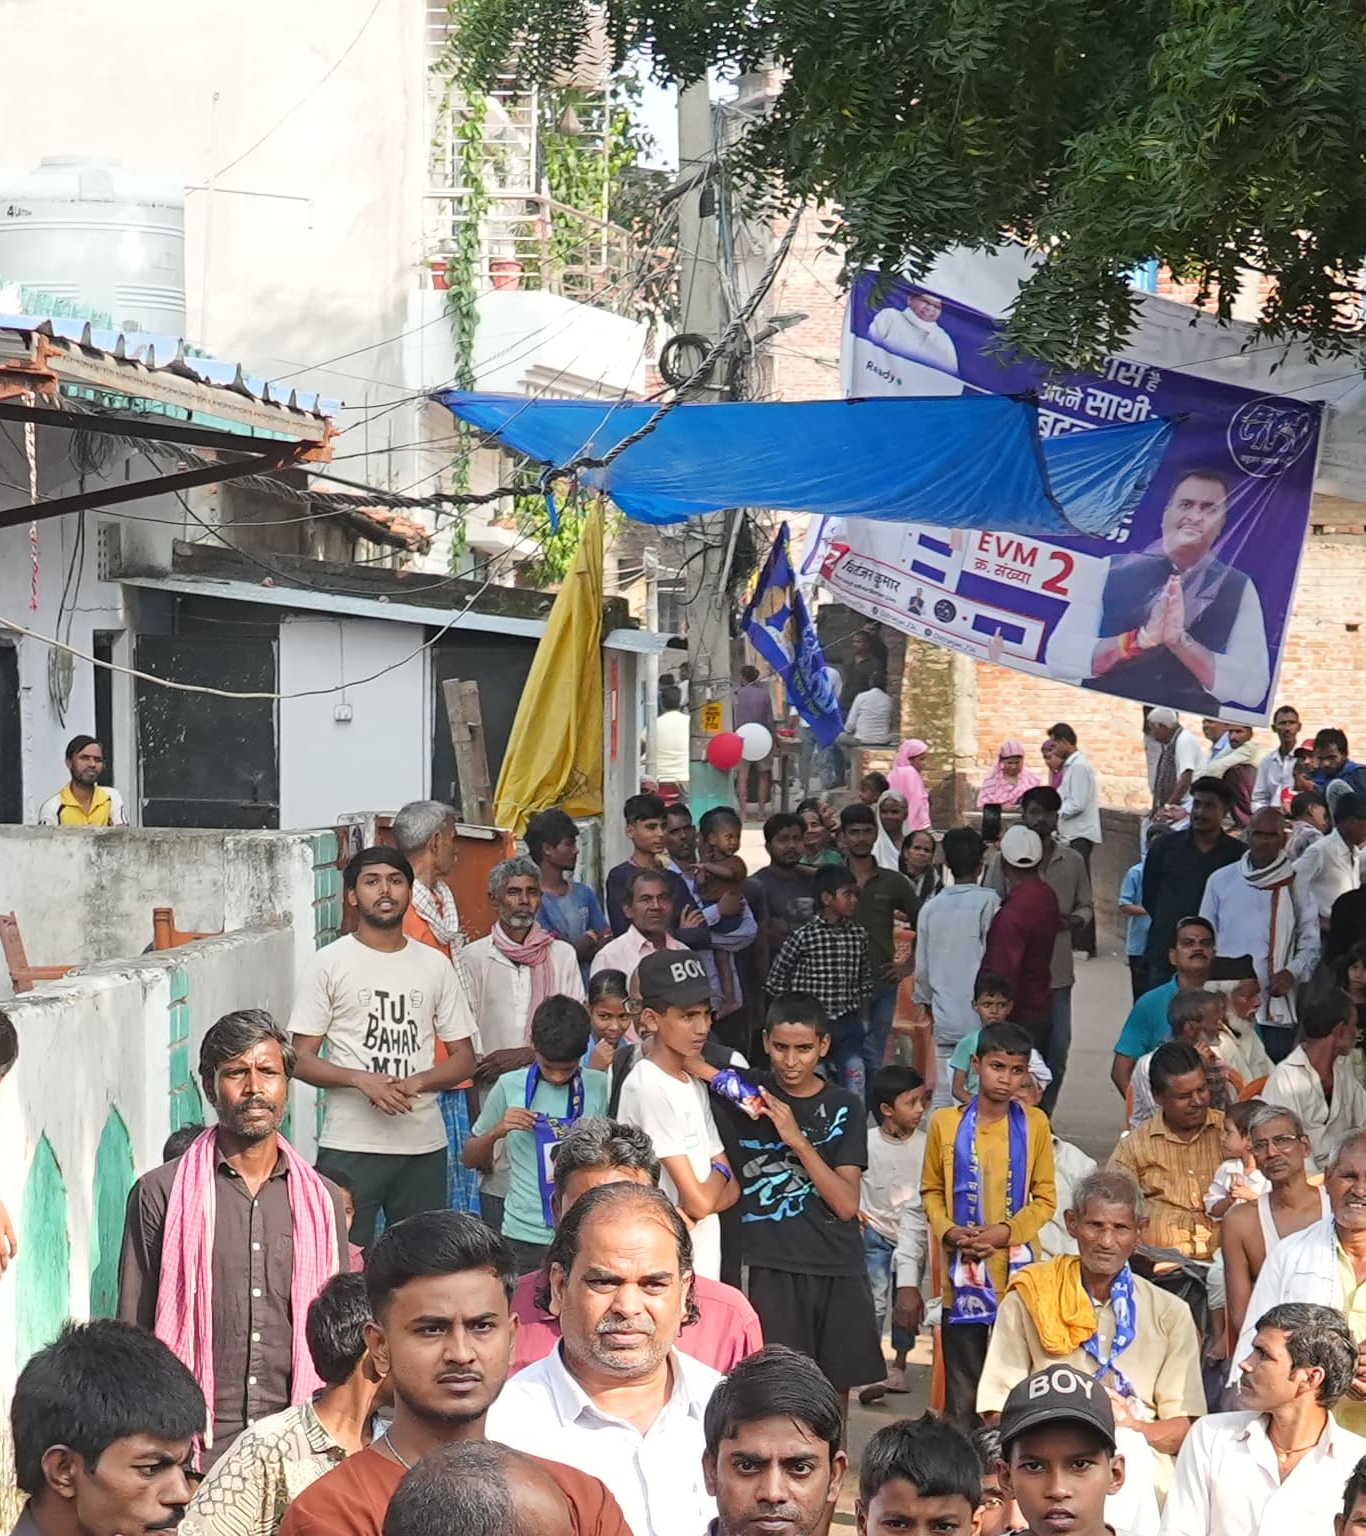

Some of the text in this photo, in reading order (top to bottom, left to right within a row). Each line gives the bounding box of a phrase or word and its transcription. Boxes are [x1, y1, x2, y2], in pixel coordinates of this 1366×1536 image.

[1085, 387, 1152, 423] साथी
[977, 531, 1039, 568] EVM
[1041, 551, 1075, 596] 2
[374, 989, 405, 1025] TU
[362, 1012, 421, 1057] BAHAR
[1029, 1369, 1093, 1400] BOY
